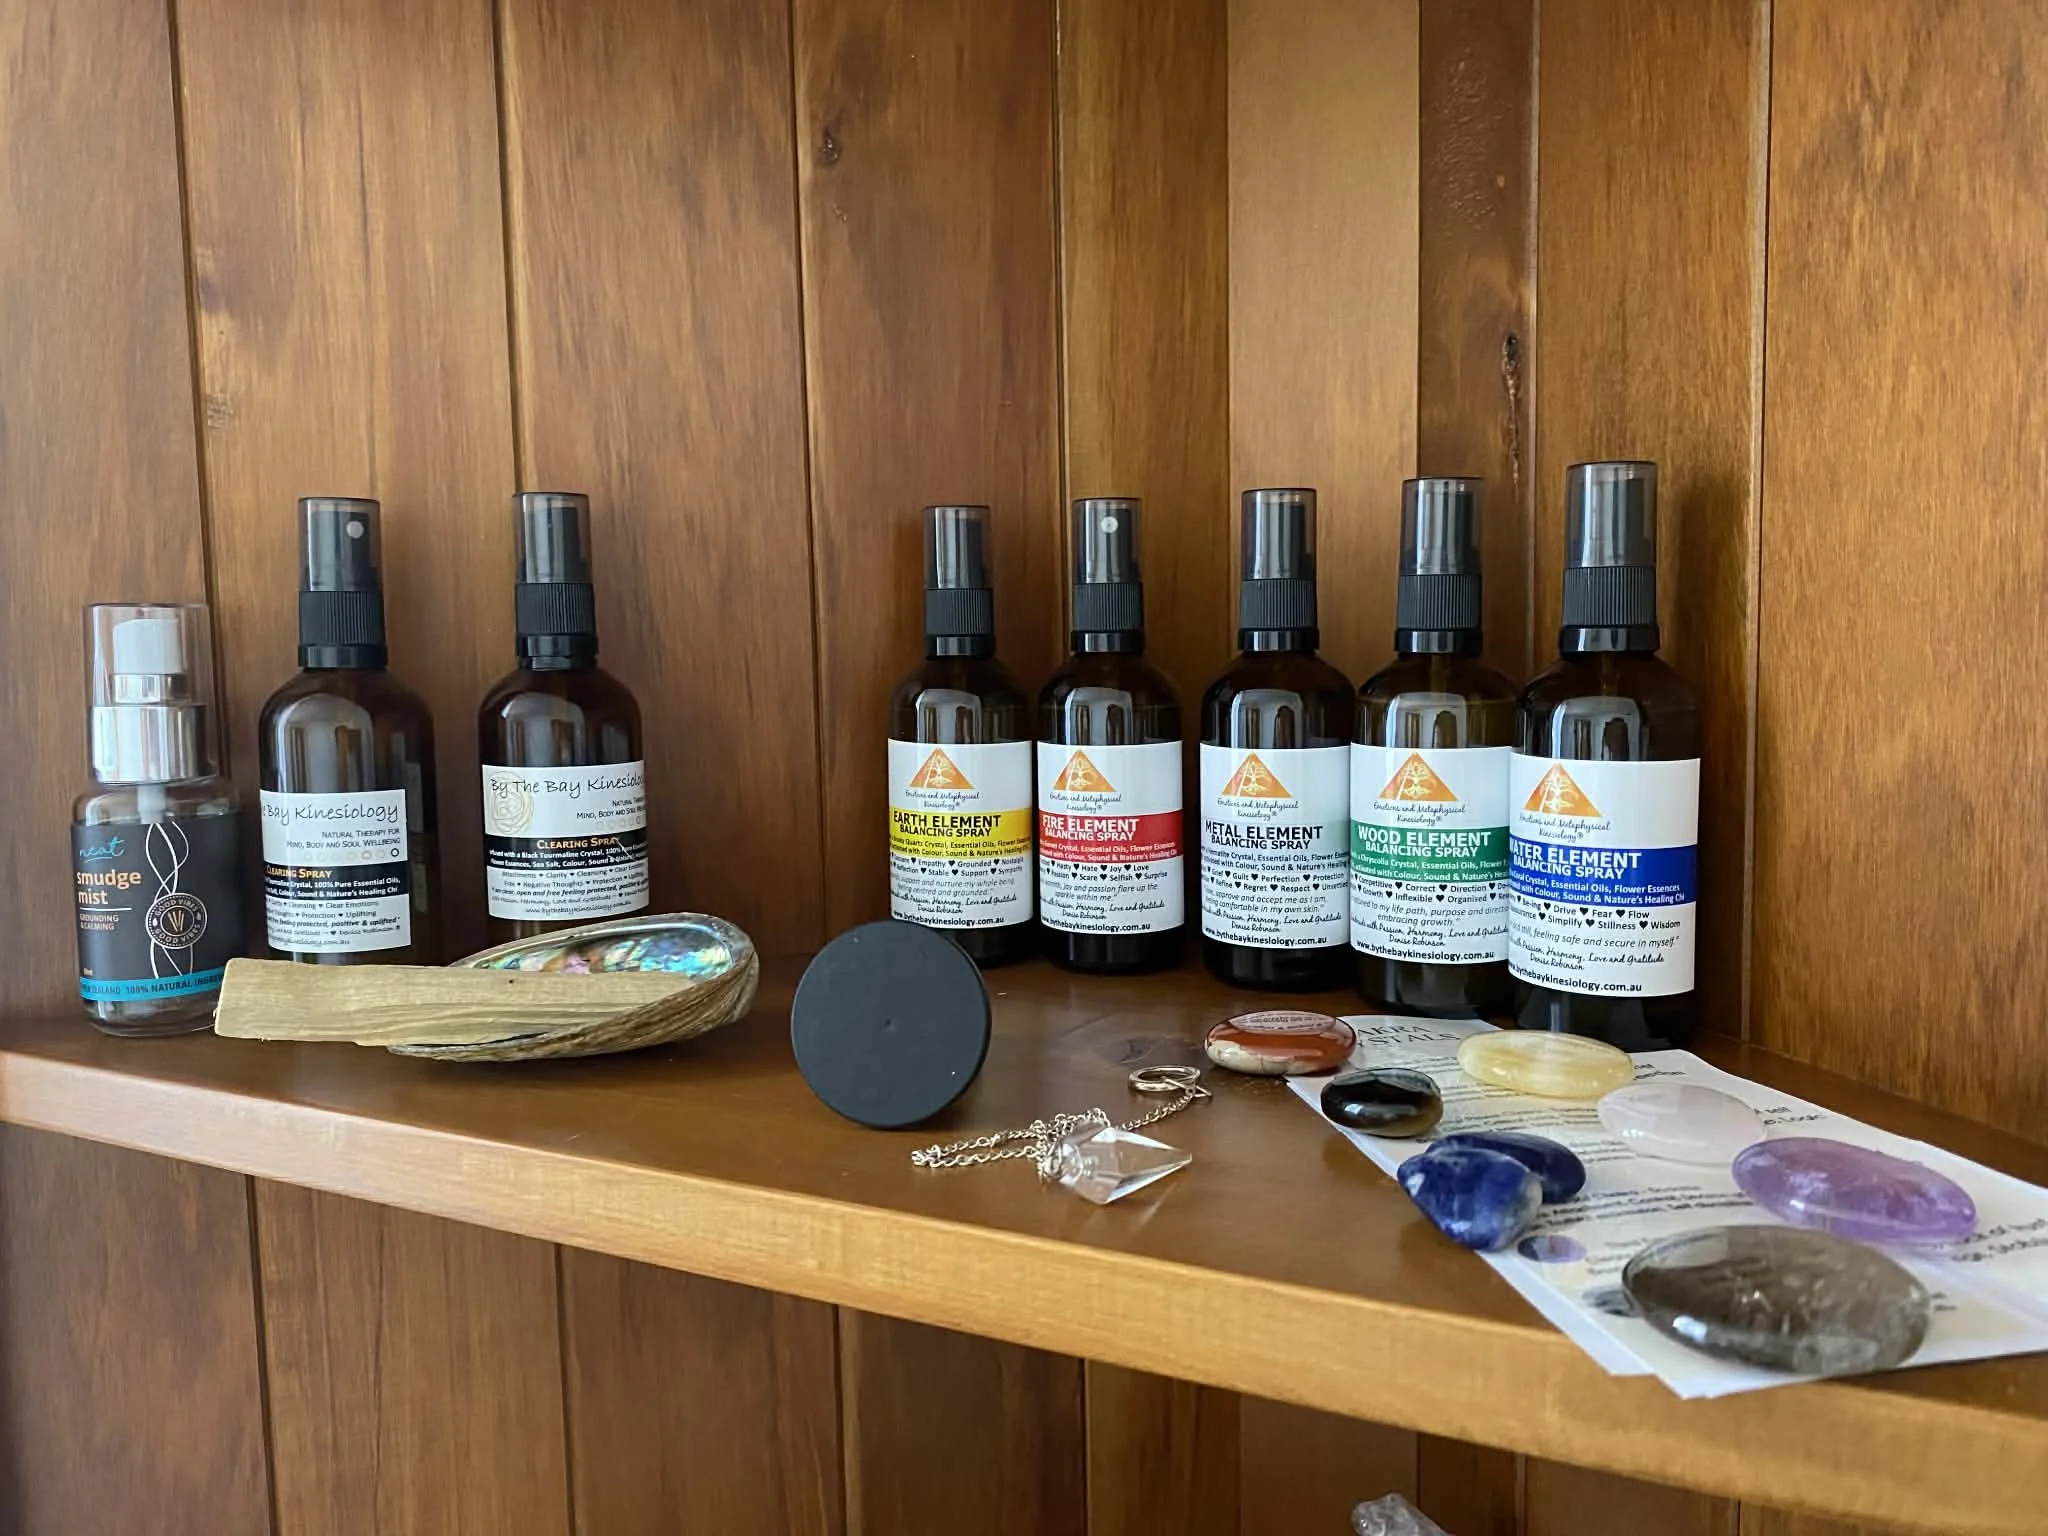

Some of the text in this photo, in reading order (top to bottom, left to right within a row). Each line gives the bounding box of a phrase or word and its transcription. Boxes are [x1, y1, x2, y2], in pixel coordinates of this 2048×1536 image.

[490, 779, 508, 799] By
[513, 779, 539, 793] The
[544, 780, 581, 799] Bay
[268, 804, 398, 826] Bay Kinesiology
[894, 811, 1002, 828] EARTH ELEMENT
[900, 824, 992, 837] BALANCING SPRAY
[1043, 815, 1139, 833] FIRE ELEMENT
[1206, 820, 1323, 840] METAL ELEMENT
[1045, 828, 1134, 841] BALANCING SPRAY
[1358, 826, 1491, 847] WOOD ELEMENT
[342, 840, 360, 848] SOUL
[537, 839, 588, 849] CLEARING
[1211, 835, 1311, 849] BALANCING SPRAY
[1365, 841, 1478, 857] BALANCING SPRAY
[1231, 852, 1256, 861] Crystal,
[1548, 848, 1642, 869] ELEMENT
[918, 860, 992, 868] Empathy Grounded
[1110, 865, 1122, 873] Joy
[1422, 862, 1459, 870] Essential
[1514, 856, 1624, 880] BALANCING SPRAY
[77, 869, 142, 889] smudge
[299, 868, 332, 878] SPRAY
[961, 869, 988, 877] Support
[1462, 872, 1493, 880] Nature's
[354, 878, 385, 887] Essential
[1244, 884, 1311, 893] Regret Respect
[1406, 883, 1436, 892] Correct
[1450, 884, 1487, 893] Direction
[1551, 881, 1589, 892] Essential
[1591, 883, 1612, 894] Oils,
[1615, 885, 1645, 893] Flower
[1648, 884, 1680, 893] Essences
[79, 888, 108, 904] mist
[359, 888, 386, 896] Healing
[1395, 893, 1433, 902] Inflexible
[1448, 894, 1487, 904] Organised
[1534, 886, 1561, 900] Colour,
[1563, 891, 1591, 901] Sound
[1594, 893, 1601, 903] &
[1604, 895, 1643, 905] Nature's
[1645, 895, 1674, 905] Healing
[155, 900, 176, 916] GOOD
[1430, 909, 1466, 917] purpose
[1553, 905, 1650, 919] Drive Fear Flow
[1377, 914, 1418, 926] embracing
[1548, 915, 1681, 930] Simplify Stillness Wisdom
[155, 929, 178, 943] GOOD
[1533, 927, 1646, 948] feeling safe and secure in
[151, 980, 192, 992] NATURAL
[1358, 1025, 1433, 1035] AKRA
[1358, 1033, 1461, 1047] STALS
